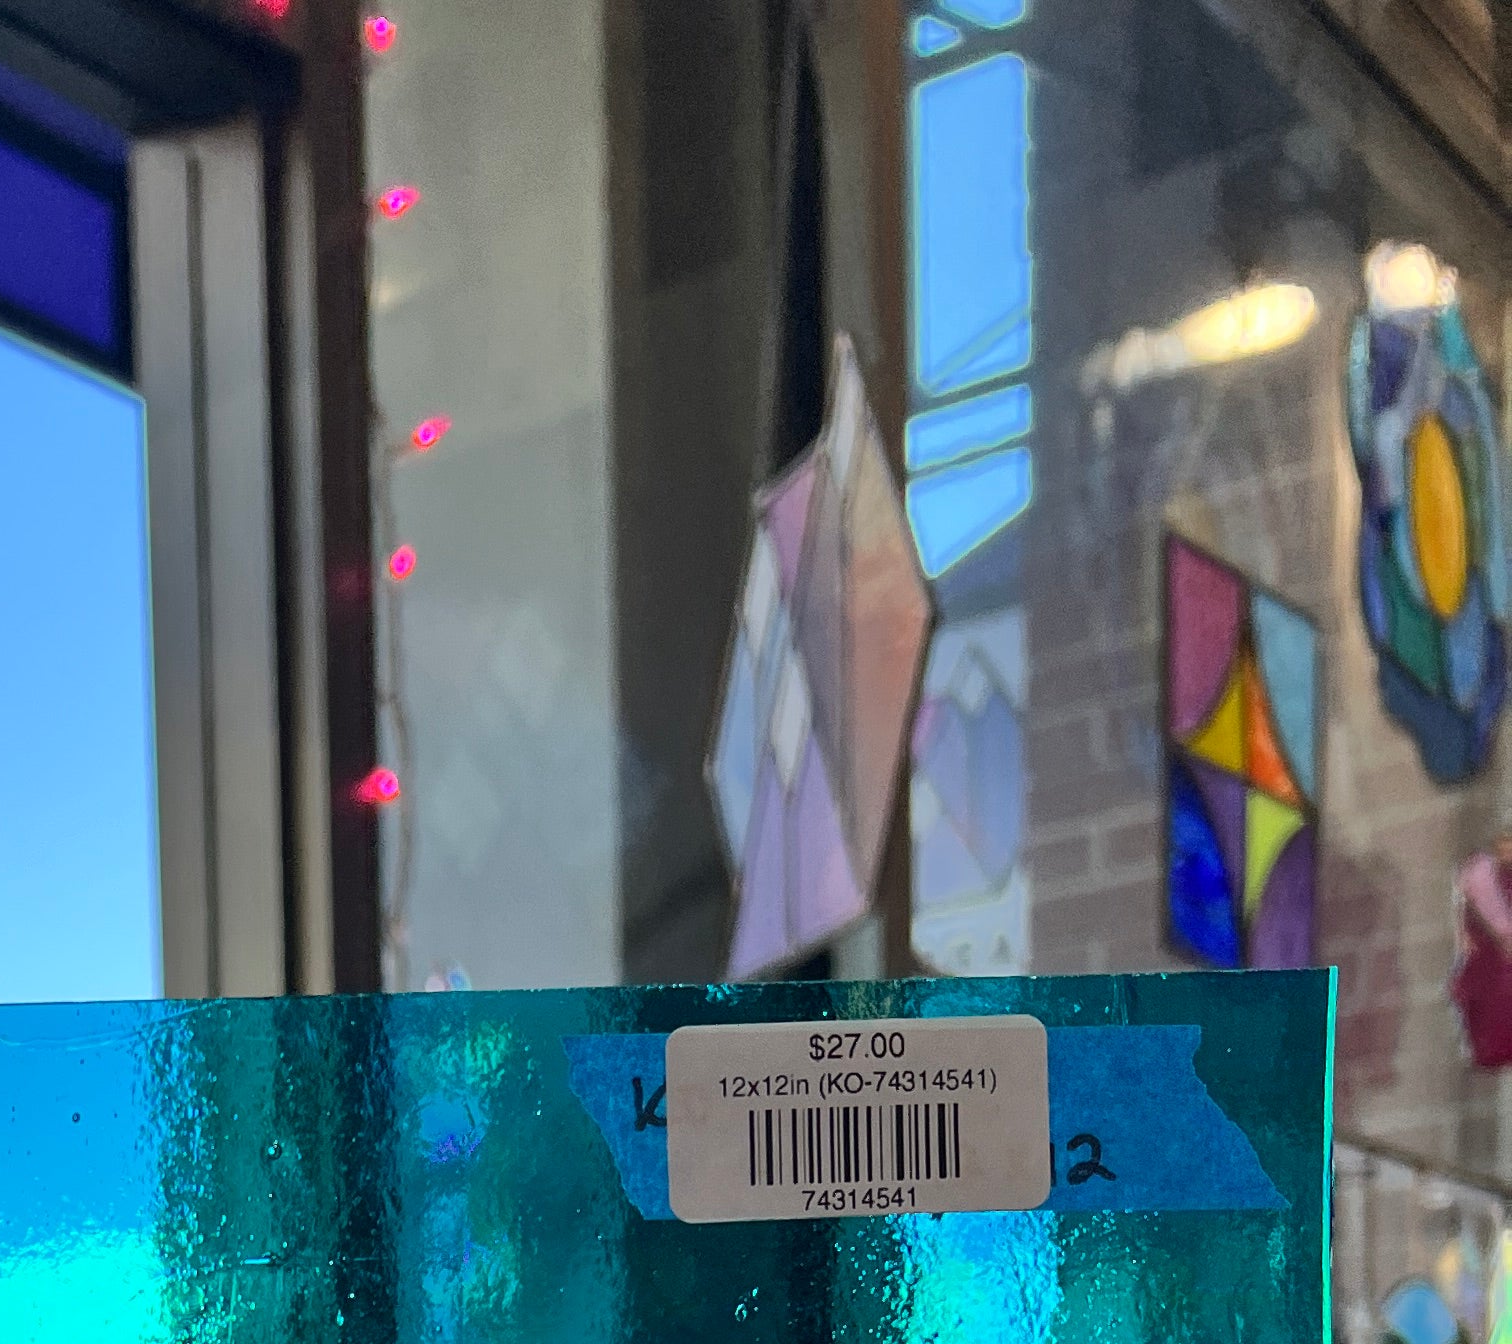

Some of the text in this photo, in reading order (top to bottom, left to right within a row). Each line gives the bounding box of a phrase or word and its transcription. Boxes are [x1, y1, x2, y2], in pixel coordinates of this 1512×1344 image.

[809, 1032, 905, 1061] $27.00
[719, 1068, 997, 1100] 12x12in (KO-74314541)
[801, 1186, 915, 1211] 74314541
